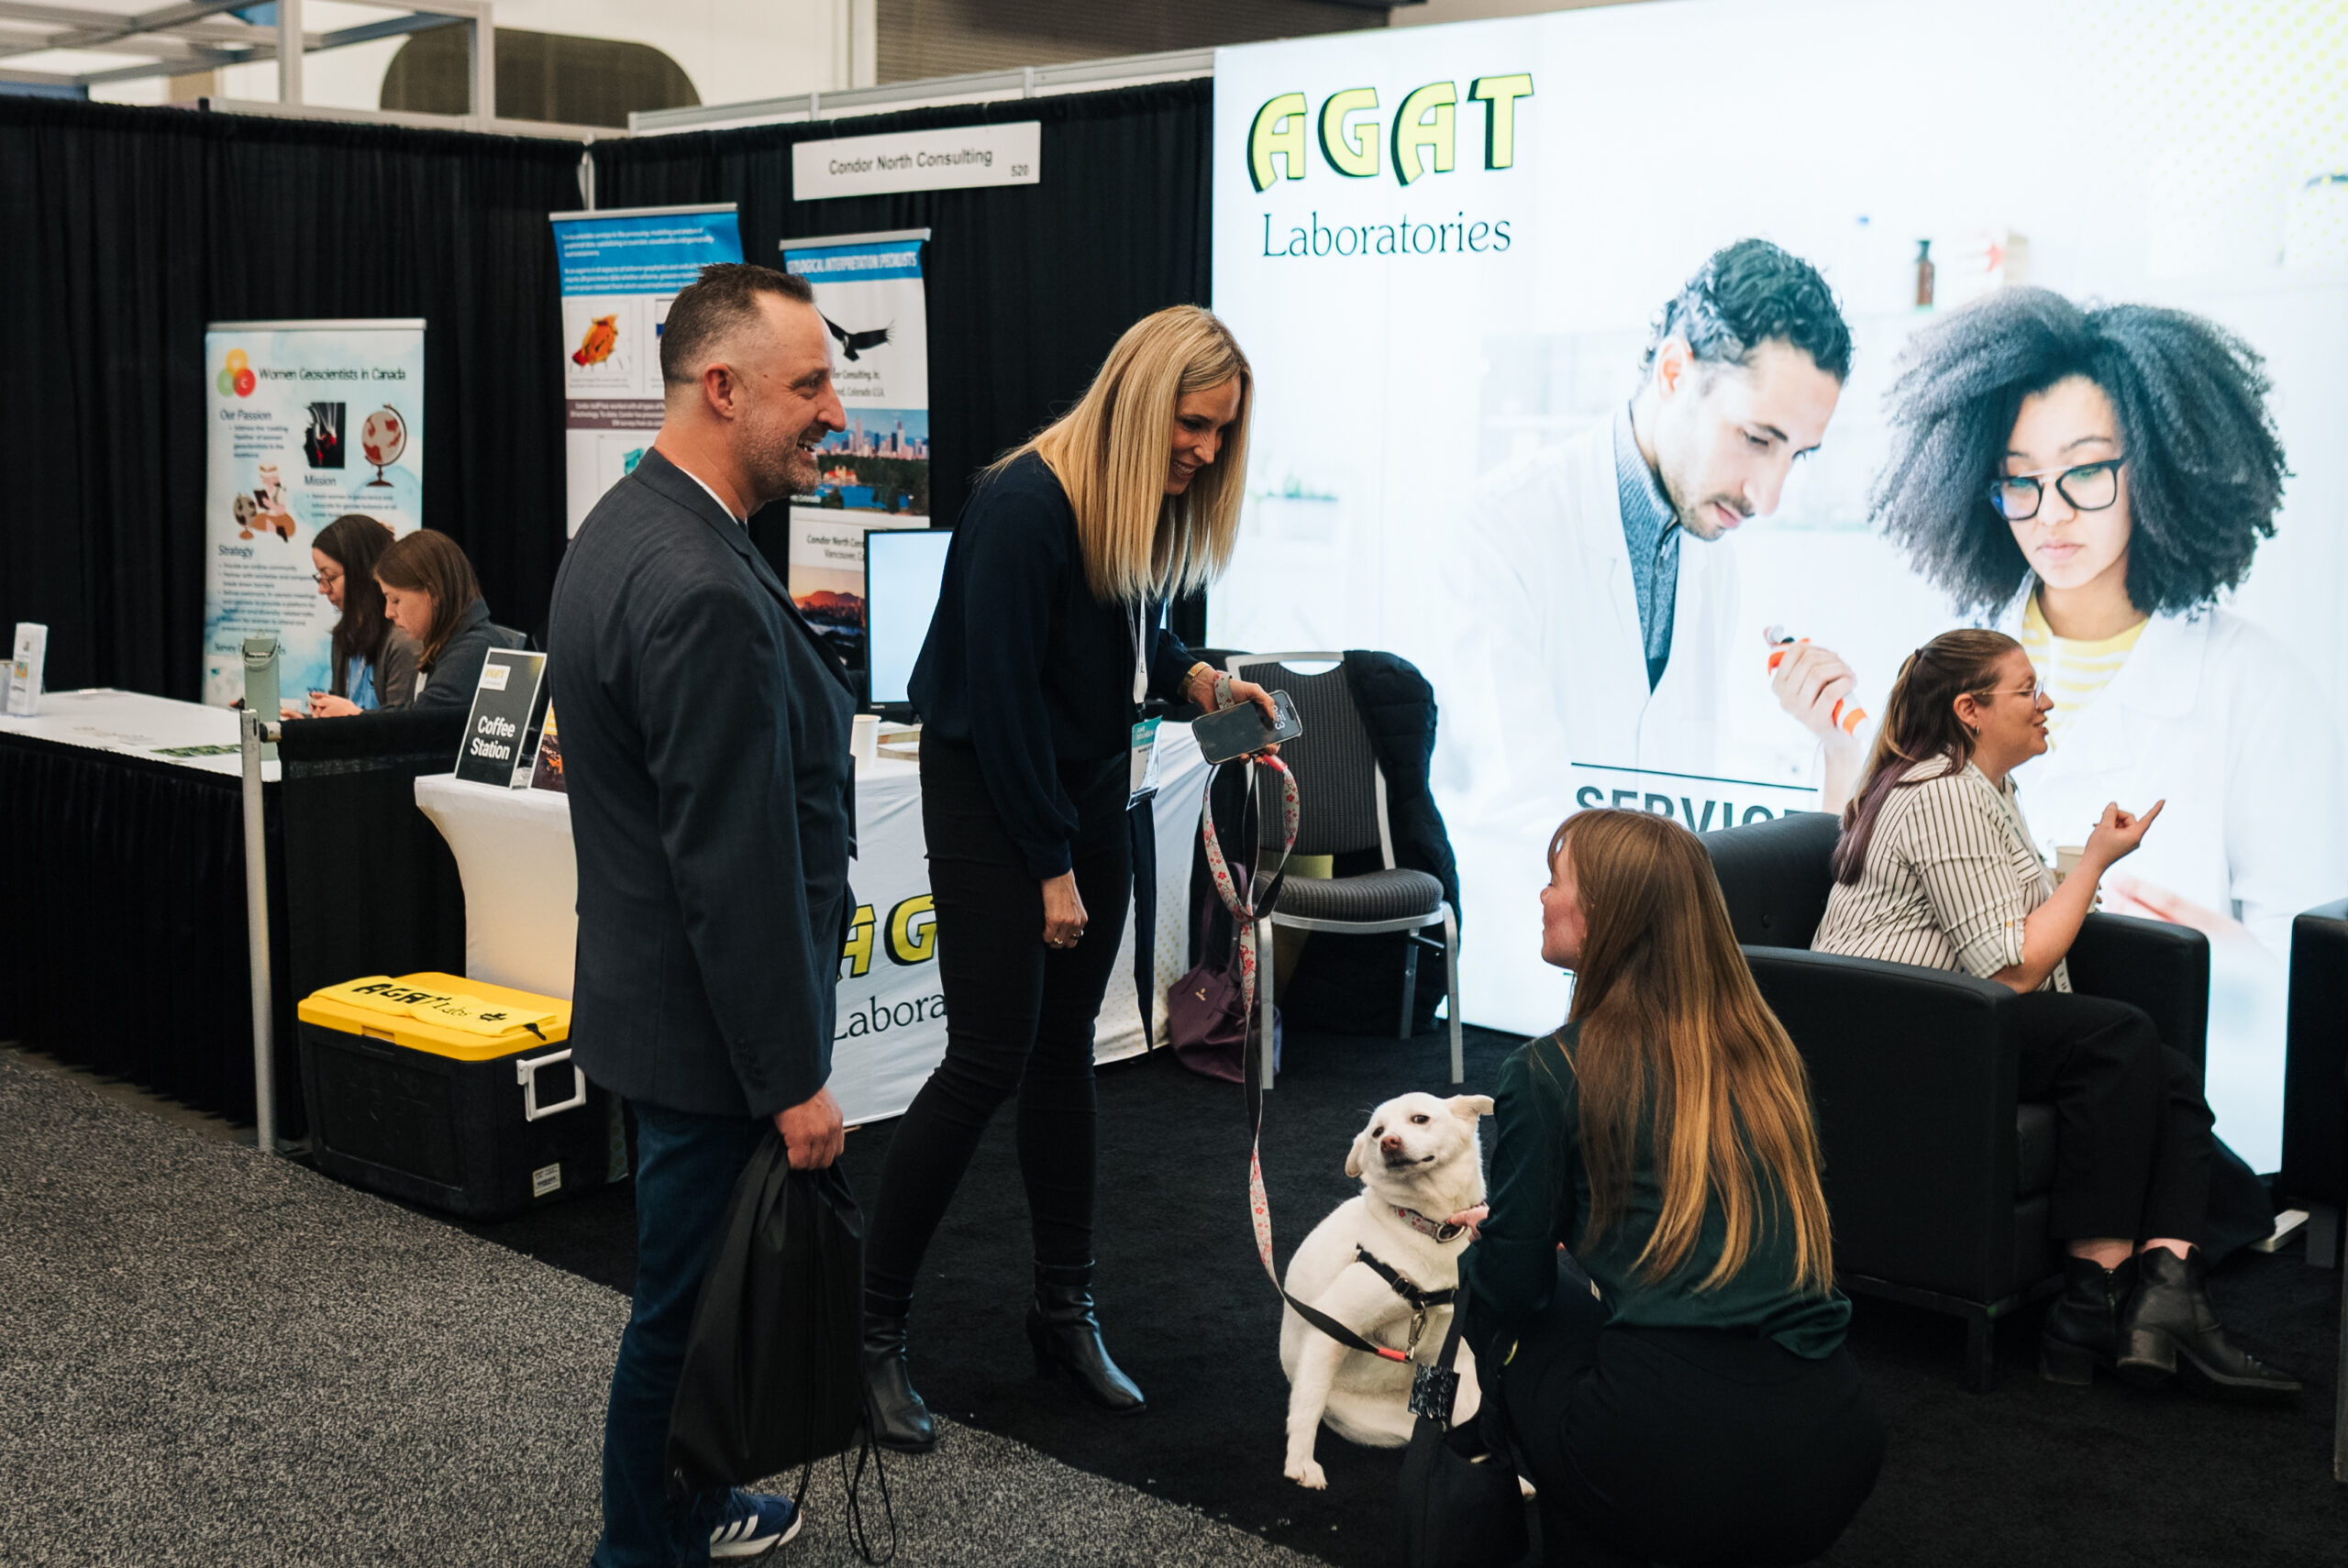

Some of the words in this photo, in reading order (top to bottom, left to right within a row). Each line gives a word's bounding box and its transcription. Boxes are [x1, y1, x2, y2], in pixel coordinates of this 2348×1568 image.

[1246, 72, 1534, 193] AGAT
[828, 158, 873, 176] Condor
[877, 154, 913, 171] North
[916, 149, 993, 168] Consulting
[1010, 163, 1030, 177] 520
[1262, 211, 1512, 258] Laboratories
[259, 368, 296, 381] Women
[371, 367, 406, 381] Canada
[237, 409, 271, 422] Passion
[304, 475, 337, 486] Mission
[477, 715, 516, 738] Coffee
[470, 737, 511, 760] Station
